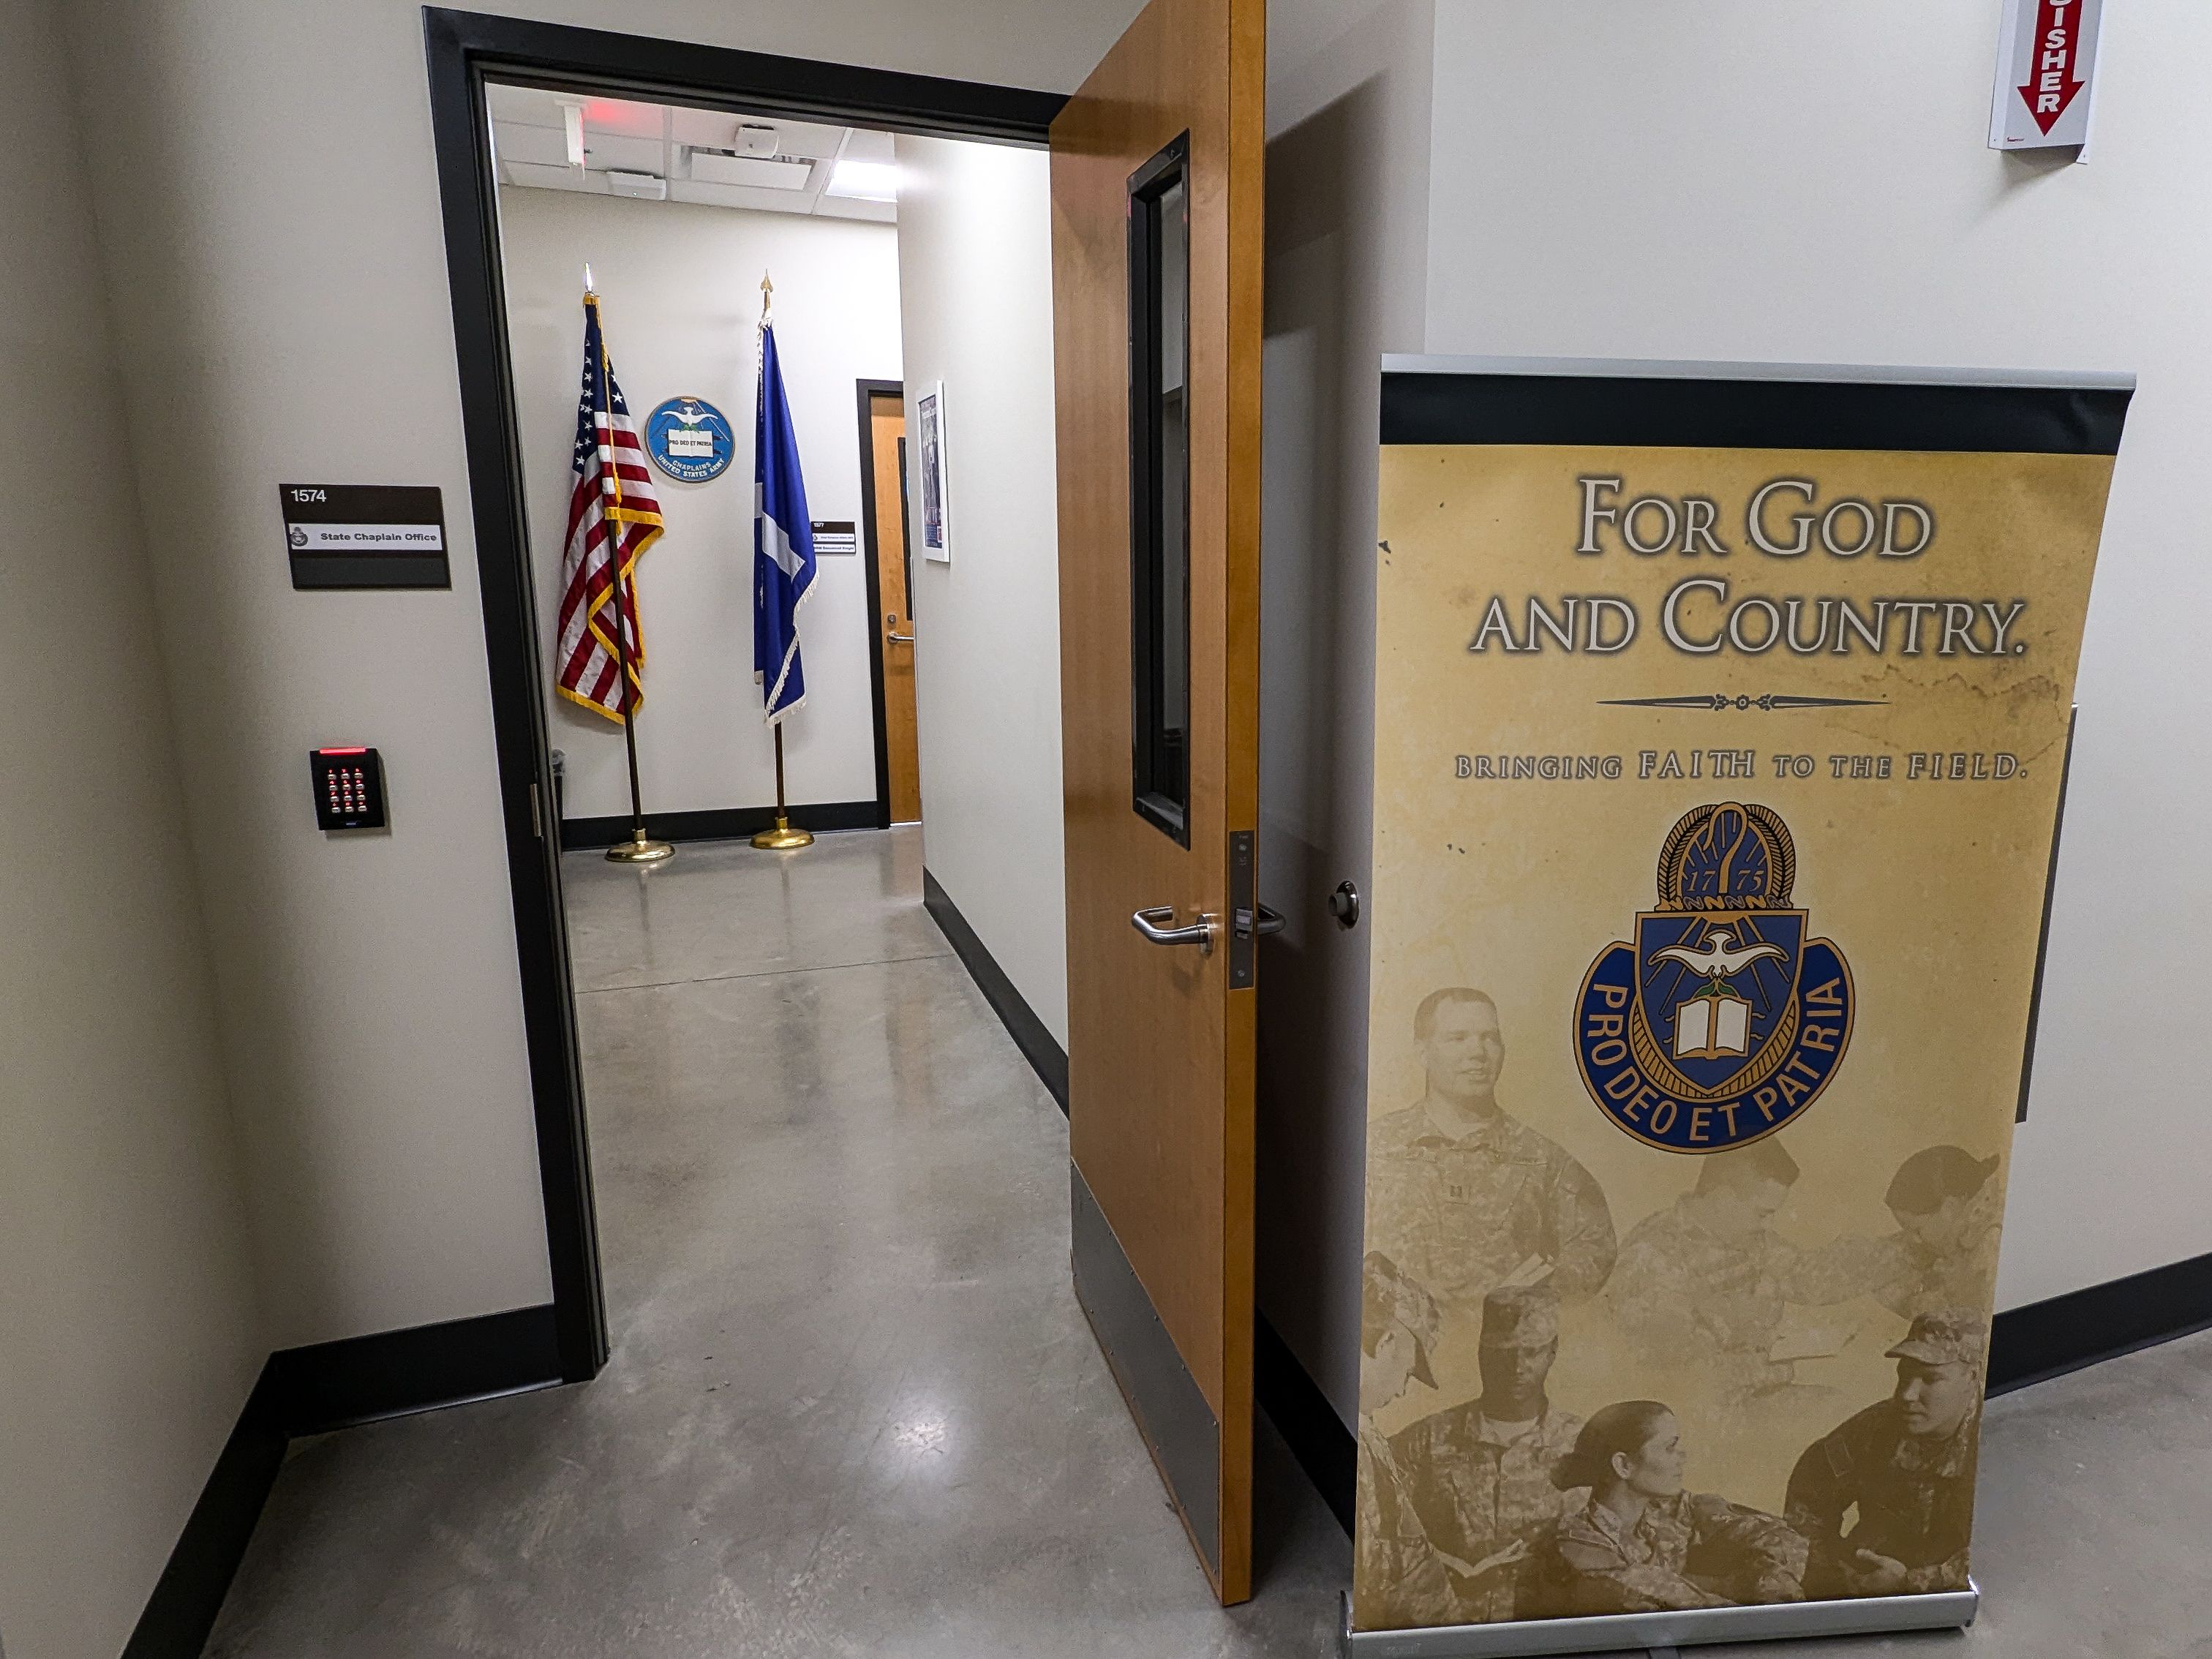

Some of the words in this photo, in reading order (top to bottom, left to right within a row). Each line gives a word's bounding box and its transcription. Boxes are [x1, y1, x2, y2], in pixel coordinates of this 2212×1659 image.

[658, 454, 681, 473] UNITED
[710, 458, 724, 473] ARMY
[672, 460, 711, 471] CHAPLAINS
[291, 489, 327, 502] 1574
[320, 533, 350, 541] State
[354, 533, 402, 542] Chaplain
[1470, 597, 1636, 652] AND
[1455, 753, 1622, 780] BRINGING
[1638, 748, 1756, 779] FAITH
[1774, 755, 1815, 779] TO
[1830, 755, 1892, 779] THE
[1906, 752, 2028, 779] FIELD.
[1587, 982, 1630, 1066] PRO
[1603, 1073, 1678, 1135] DEO
[1689, 1102, 1740, 1141] ET
